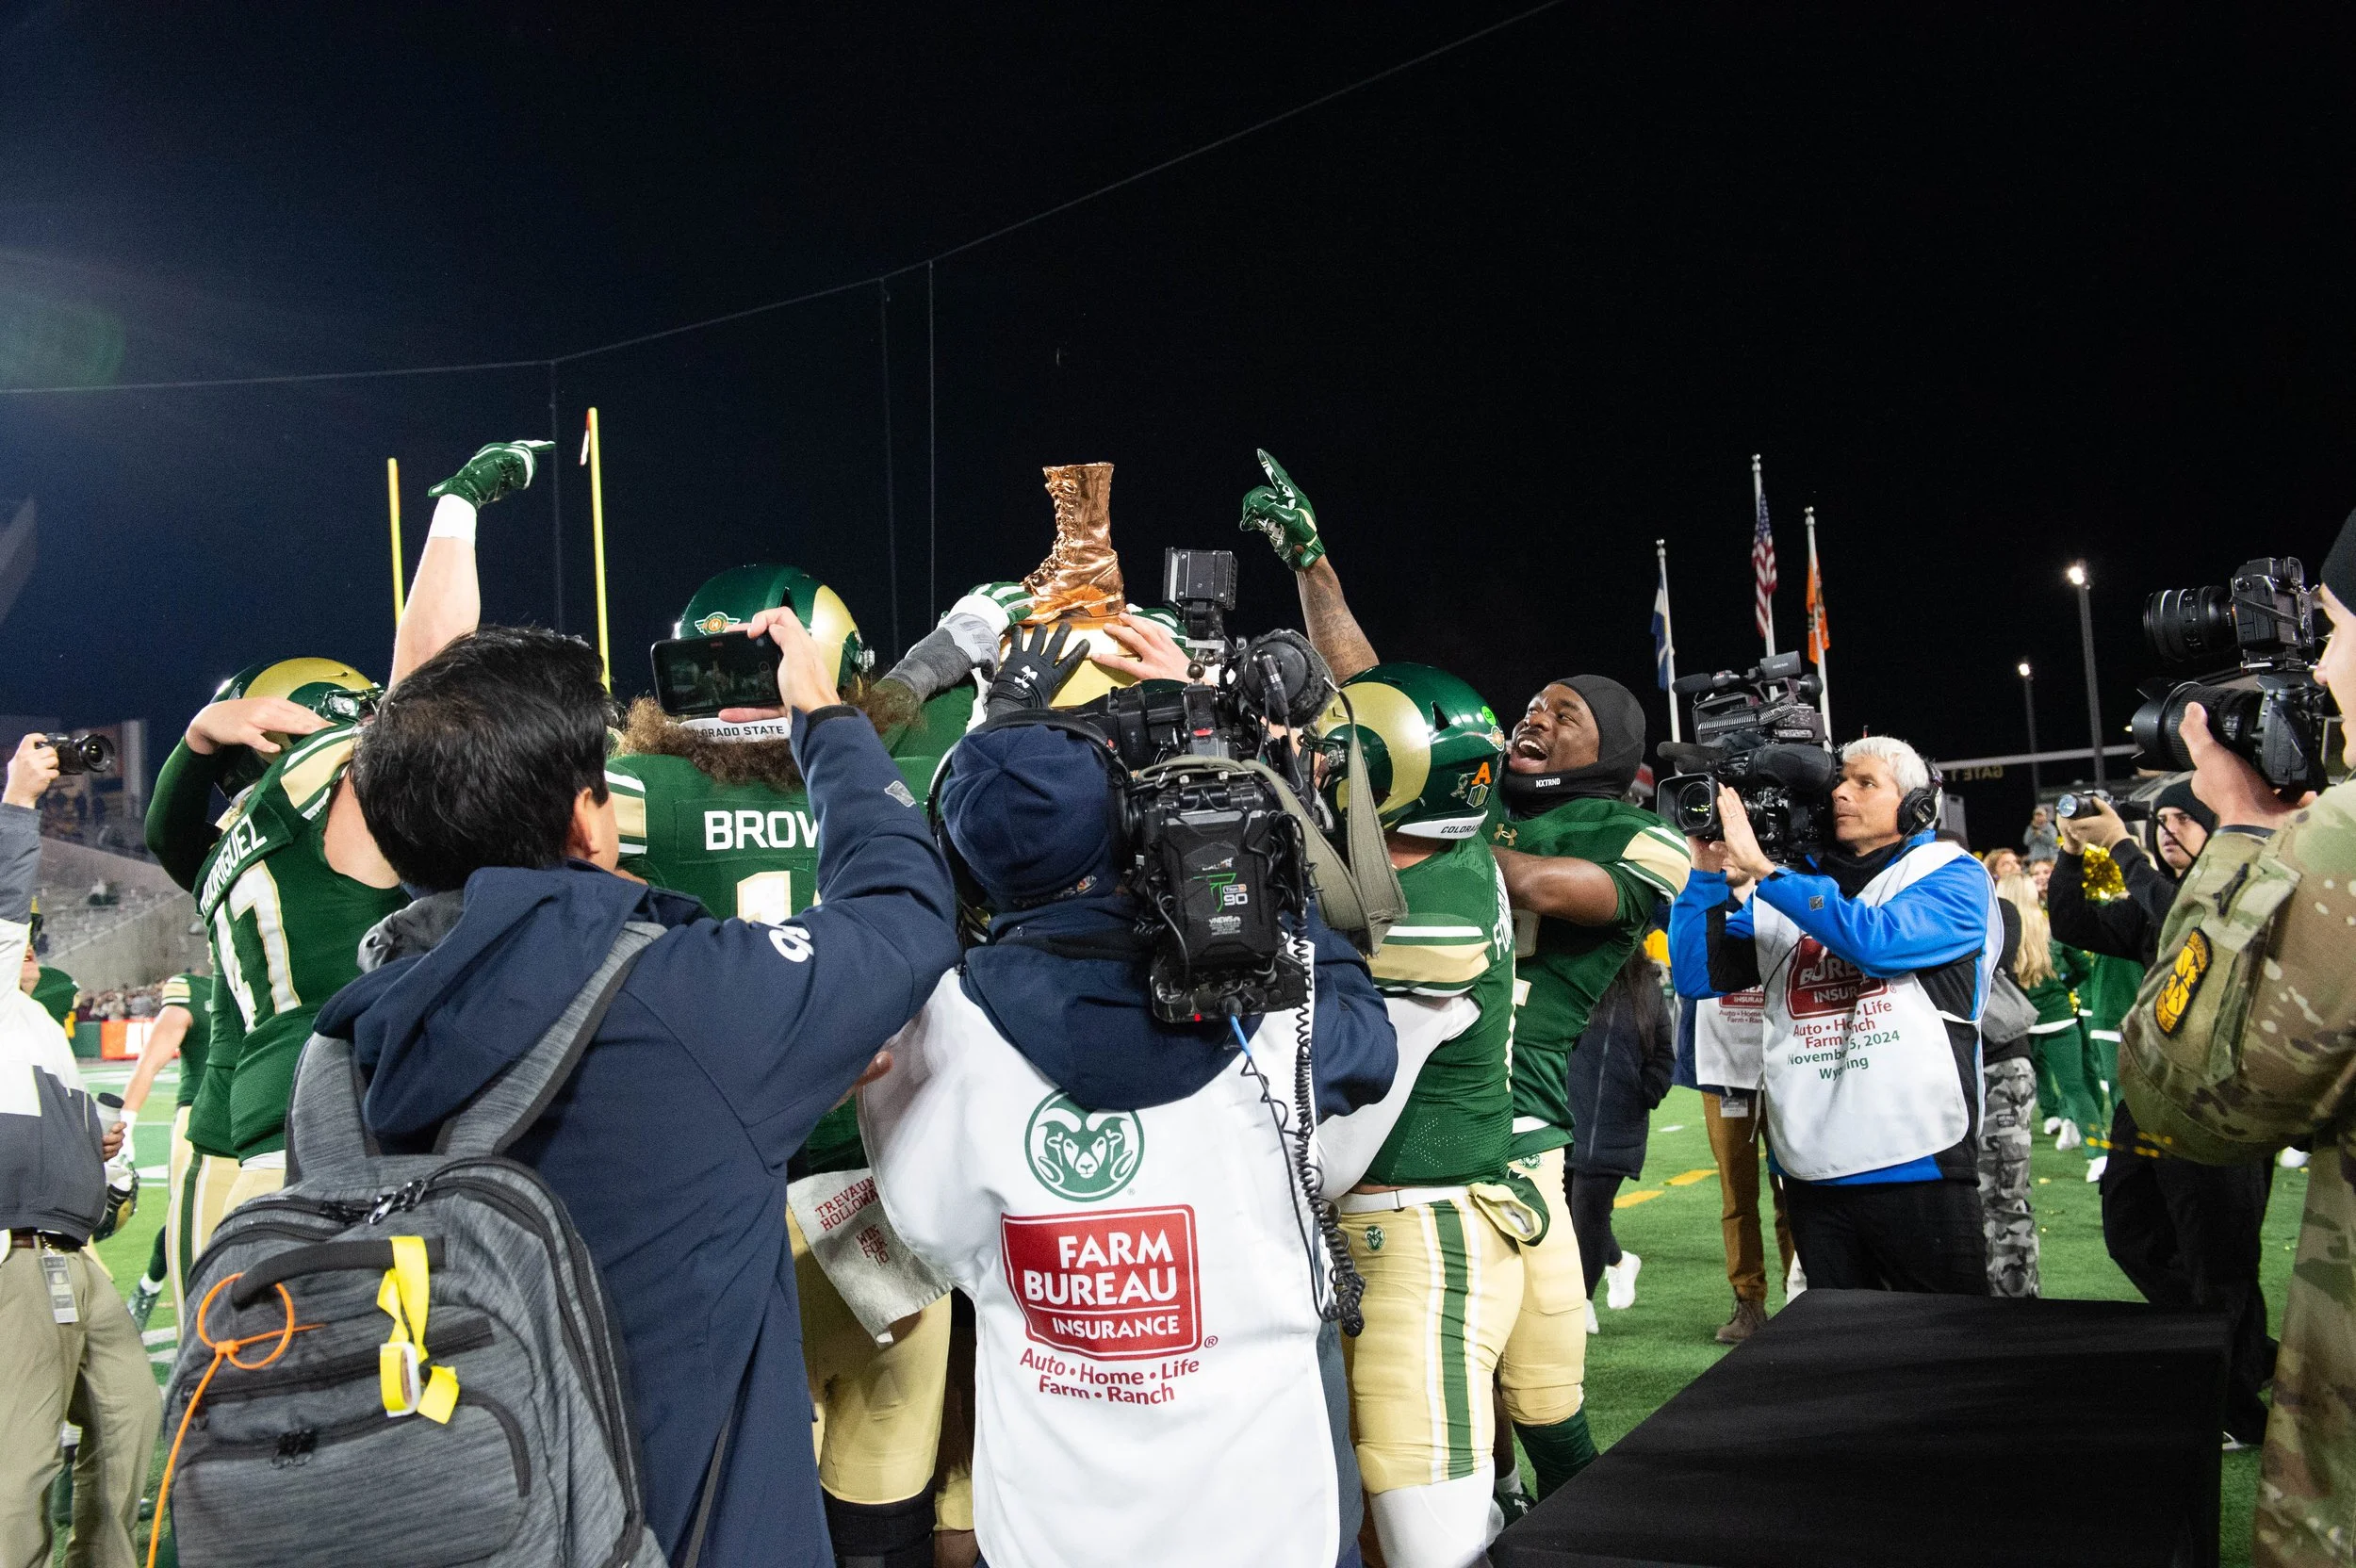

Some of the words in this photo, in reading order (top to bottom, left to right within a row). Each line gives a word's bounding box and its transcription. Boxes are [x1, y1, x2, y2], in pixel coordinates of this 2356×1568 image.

[690, 725, 740, 739] OLORADO
[743, 725, 785, 736] STATE
[1471, 761, 1492, 786] A
[1535, 777, 1562, 789] NXTRND
[1223, 892, 1249, 906] 90
[1792, 1023, 1823, 1037] Auto
[1863, 1001, 1892, 1017] Life
[1806, 1037, 1842, 1049] Farm
[1863, 1029, 1901, 1048] 2024
[814, 1175, 875, 1219] TREVAUN
[856, 1224, 881, 1247] WIN
[1058, 1228, 1174, 1269] FARM
[1023, 1266, 1178, 1307] BUREAU
[1052, 1315, 1181, 1340] INSURANCE
[1020, 1348, 1066, 1377] Auto
[1079, 1362, 1145, 1386] Home
[1161, 1358, 1201, 1380] Life
[1039, 1374, 1090, 1400] Farm
[1106, 1382, 1175, 1405] Ranch
